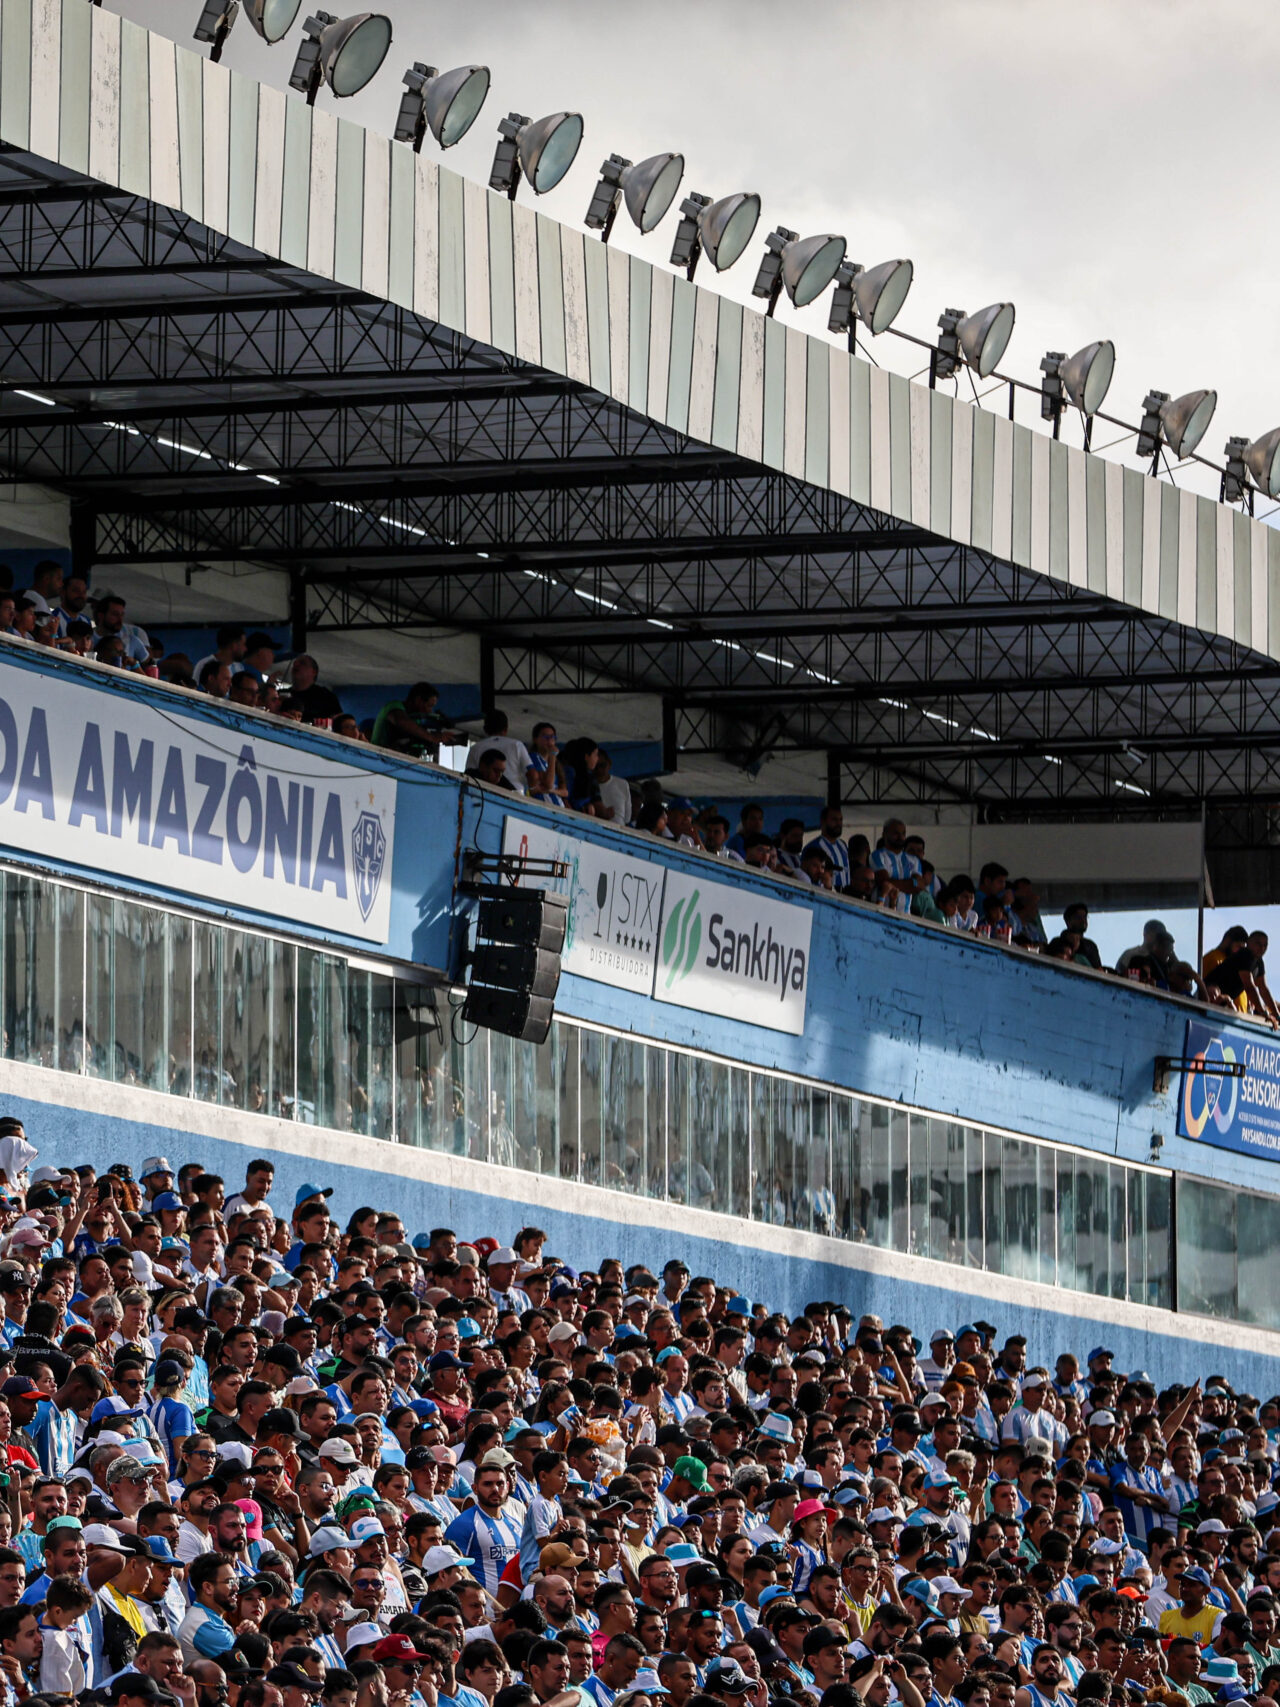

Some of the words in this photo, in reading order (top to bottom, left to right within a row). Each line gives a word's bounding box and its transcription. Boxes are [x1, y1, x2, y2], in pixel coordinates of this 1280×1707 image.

[67, 722, 349, 900] AMAZÔNIA
[617, 872, 658, 932] STX
[589, 946, 650, 978] DISTRIBUIDORA
[705, 913, 806, 1002] Sankhya
[1240, 1074, 1280, 1110] SENSORI
